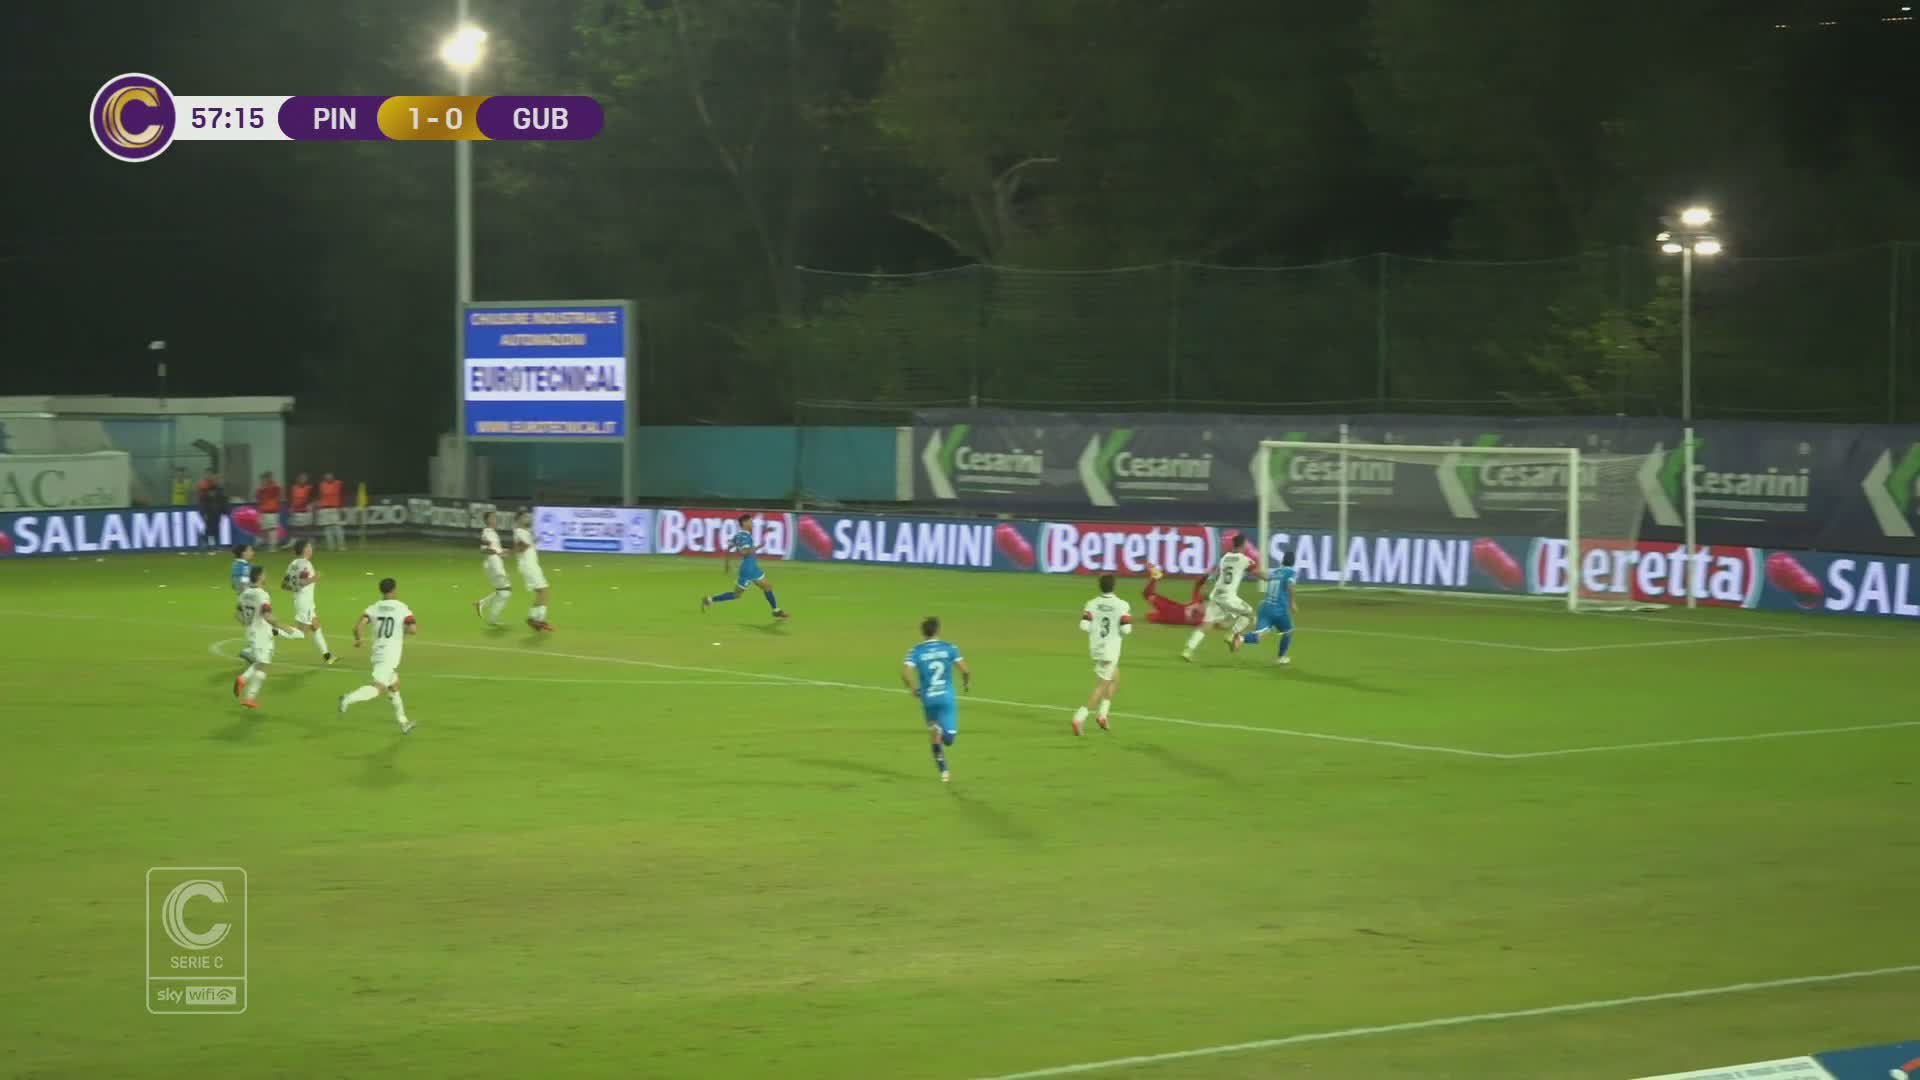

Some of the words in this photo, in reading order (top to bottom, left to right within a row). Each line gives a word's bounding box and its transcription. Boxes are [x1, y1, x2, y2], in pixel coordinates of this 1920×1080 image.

[472, 366, 621, 392] EUROTECNICAL
[955, 445, 1043, 473] Cesarini
[1114, 452, 1212, 478] Cesarini
[660, 510, 786, 556] Bereta
[832, 519, 994, 567] SALAMINI
[1047, 522, 1206, 575] Beretta
[1543, 538, 1745, 602] Beretta
[376, 616, 395, 639] 70
[1100, 616, 1111, 639] 3
[928, 661, 946, 685] 2
